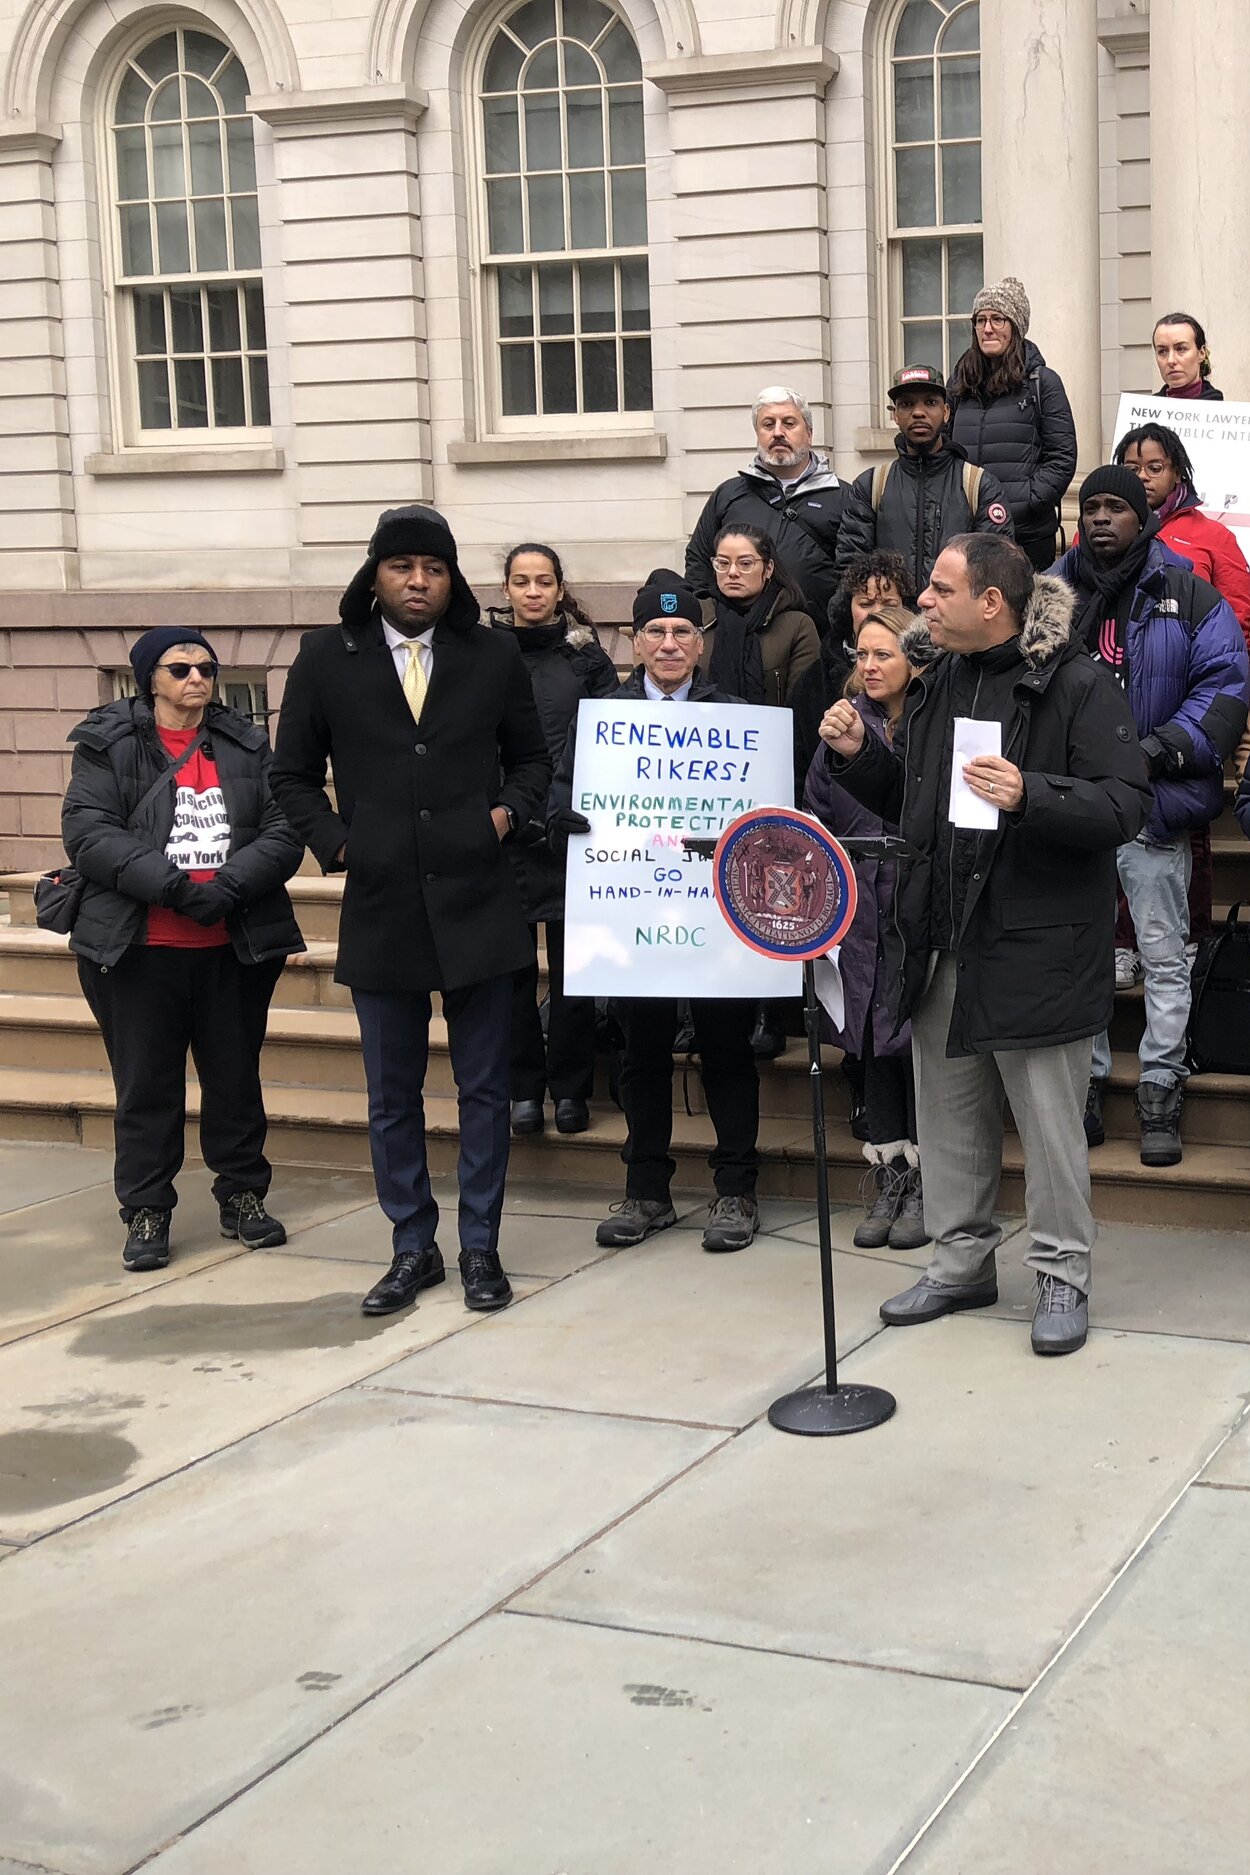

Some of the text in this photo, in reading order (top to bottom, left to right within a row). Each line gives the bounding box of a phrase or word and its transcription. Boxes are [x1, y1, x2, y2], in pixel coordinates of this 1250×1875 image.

[1131, 407, 1162, 418] NEW
[1166, 410, 1200, 422] YORK
[595, 721, 760, 751] RENEWABLE
[637, 756, 750, 783] RIKERS!
[193, 850, 223, 864] York
[585, 848, 656, 863] SOCIAL
[654, 867, 683, 882] GO
[772, 920, 795, 929] 1625
[635, 925, 707, 947] NRDC
